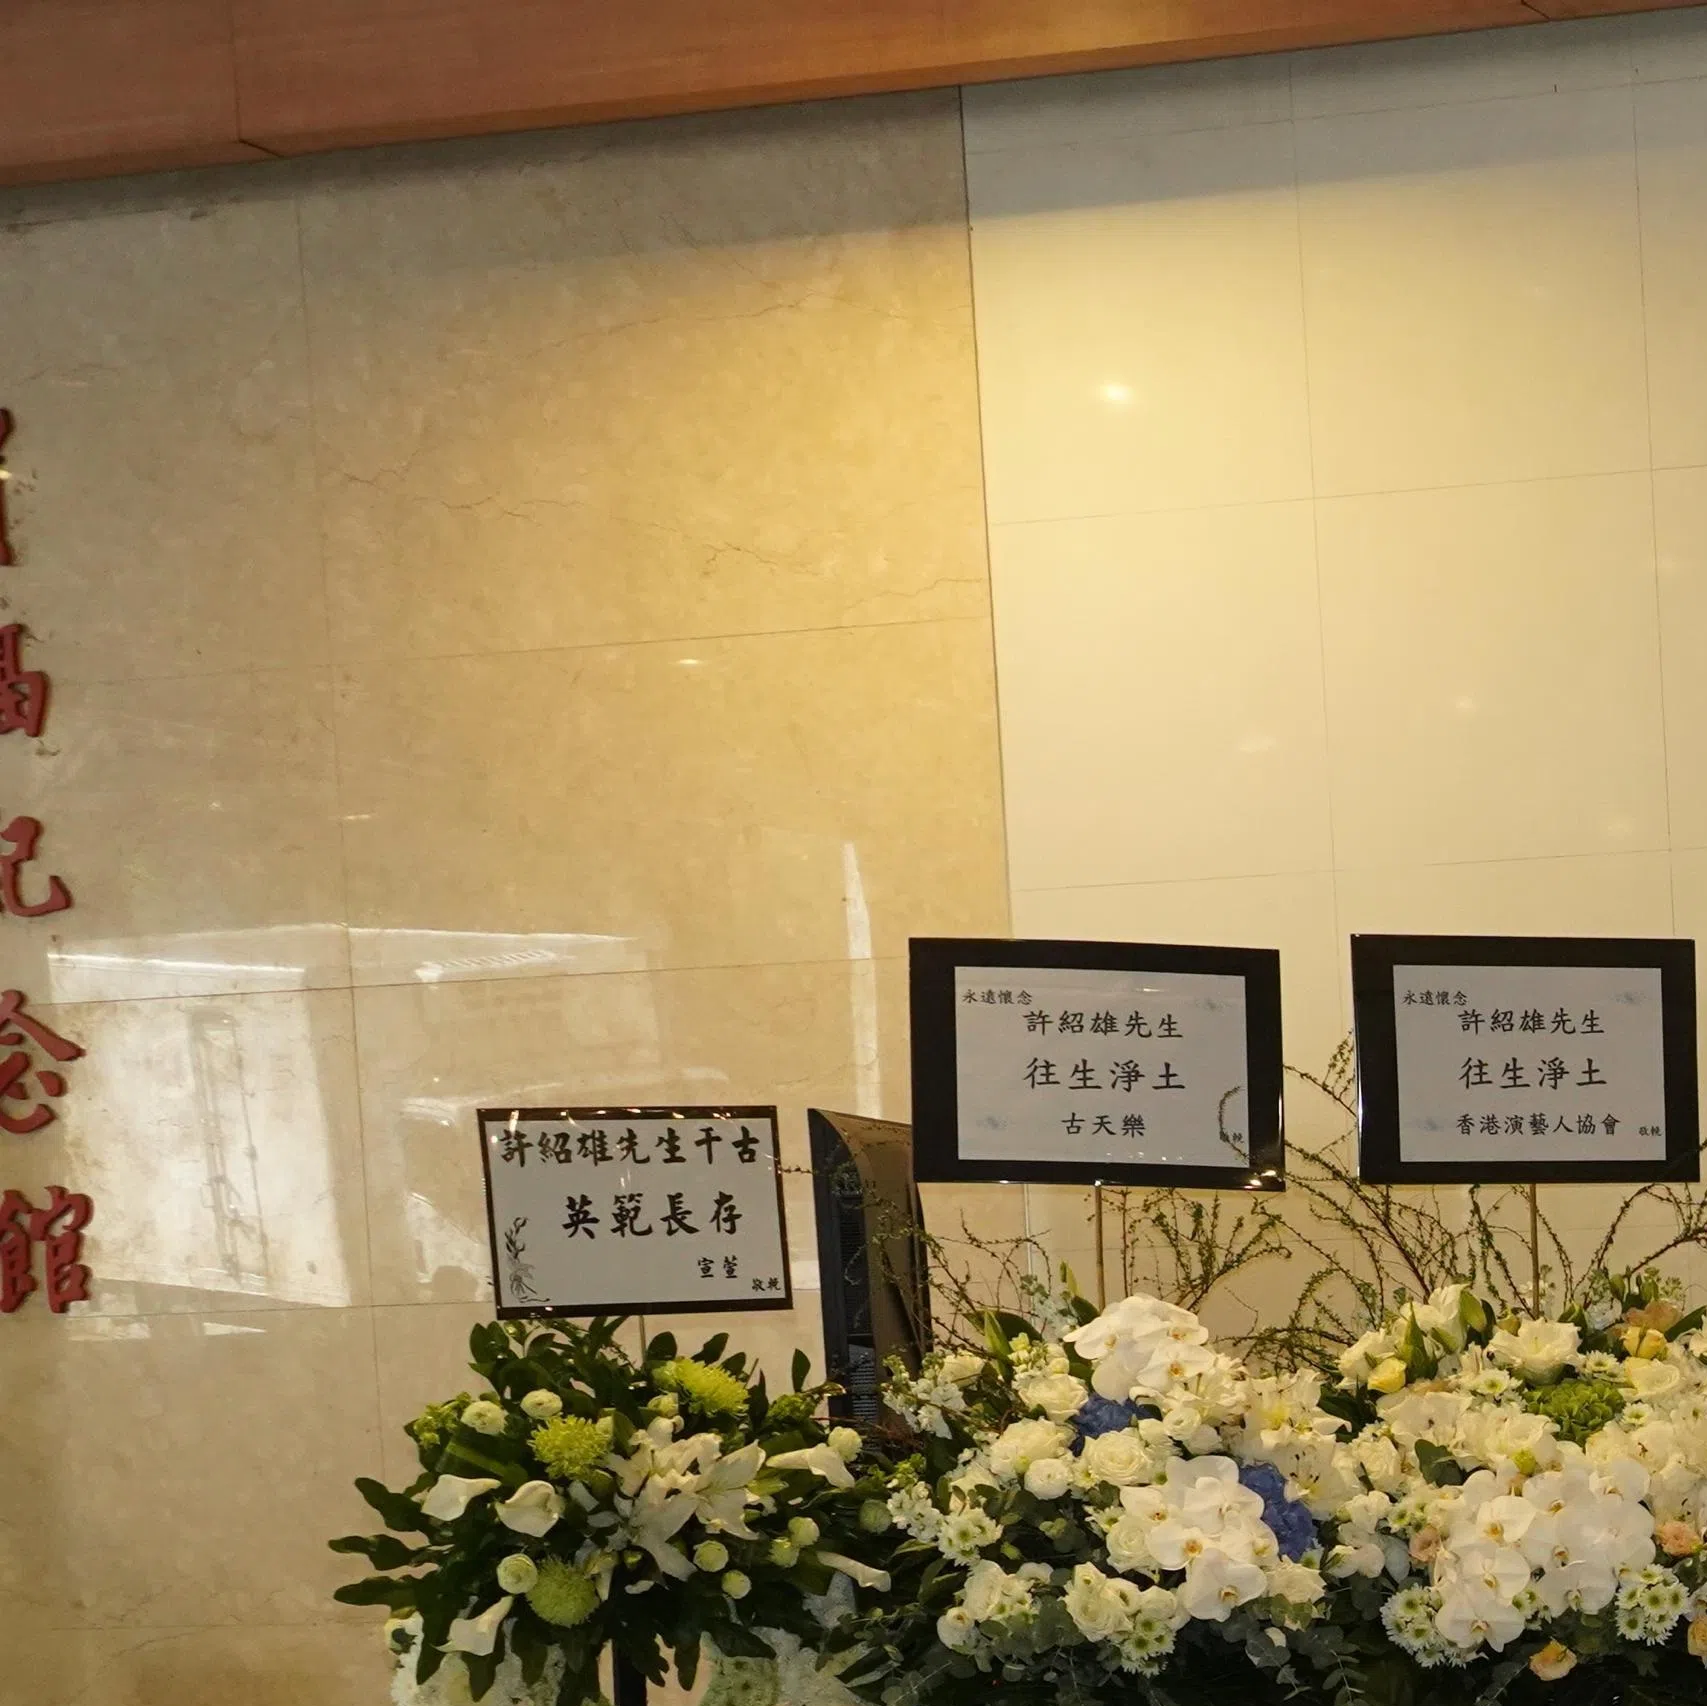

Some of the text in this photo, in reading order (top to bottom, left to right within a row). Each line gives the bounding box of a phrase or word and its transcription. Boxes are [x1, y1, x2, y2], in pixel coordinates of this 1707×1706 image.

[963, 989, 1032, 1005] 永遠懷念
[1403, 990, 1467, 1006] 永遠懷念
[1023, 1010, 1183, 1038] 許紹雄先生
[1458, 1007, 1604, 1035] 許紹雄先生
[1023, 1057, 1185, 1093] 往生淨土
[1459, 1057, 1607, 1090] 往生淨土
[1061, 1112, 1146, 1138] 古天樂
[1456, 1112, 1621, 1136] 香港演藝人協會
[499, 1126, 760, 1167] 許紹雄先生千古
[562, 1191, 742, 1240] 英範長存
[697, 1255, 738, 1279] 宣萱
